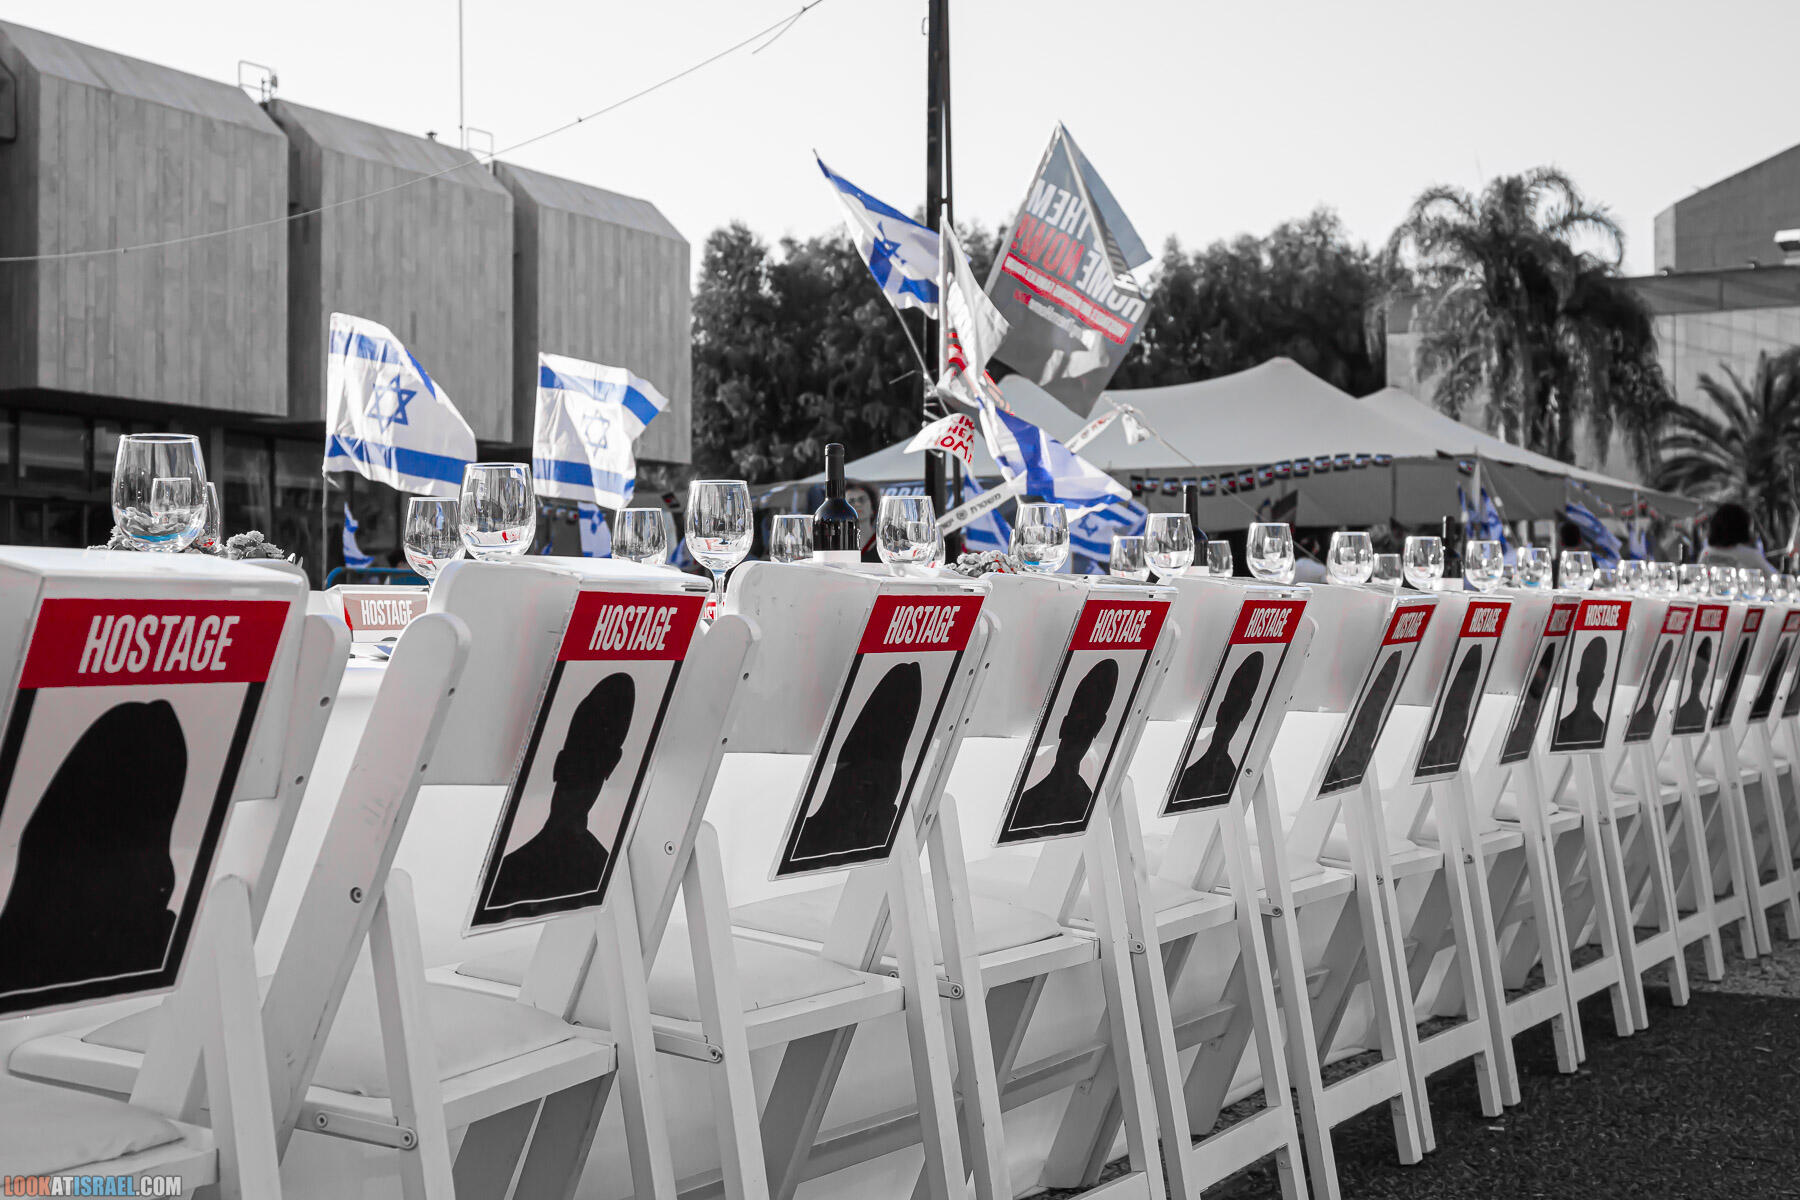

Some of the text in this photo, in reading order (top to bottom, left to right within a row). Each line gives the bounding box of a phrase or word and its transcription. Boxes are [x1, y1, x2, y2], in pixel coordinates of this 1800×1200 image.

[360, 599, 413, 626] HOSTAGE
[588, 604, 678, 651] HOSTAGE
[883, 605, 961, 645] HOSTAGE
[1088, 608, 1152, 643] HOSTAGE
[1243, 607, 1293, 639] HOSTAGE
[1391, 611, 1426, 640] HOSTAGE
[1468, 607, 1502, 633] HOSTAGE
[1584, 604, 1622, 627] HOSTAGE
[77, 614, 241, 674] HOSTAGE
